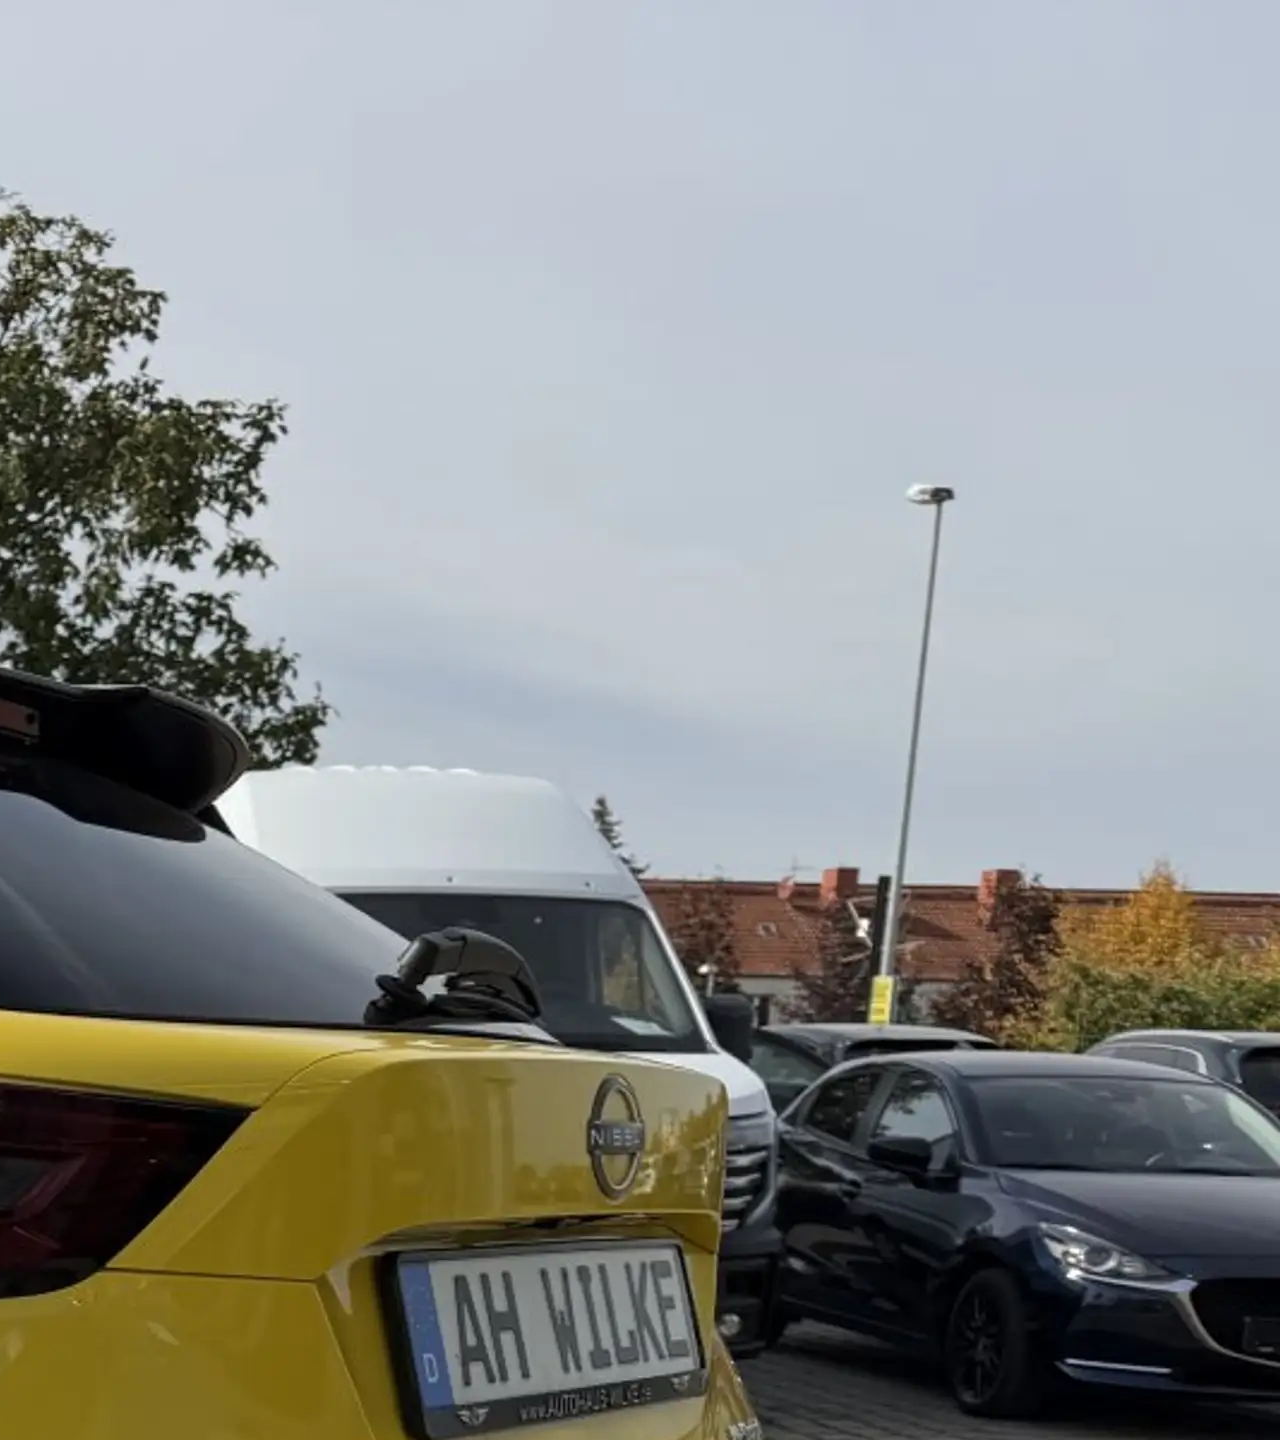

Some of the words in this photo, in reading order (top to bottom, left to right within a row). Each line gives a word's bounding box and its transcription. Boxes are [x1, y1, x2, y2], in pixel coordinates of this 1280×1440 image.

[591, 1126, 642, 1147] NISS
[454, 1270, 531, 1387] AH
[540, 1260, 689, 1373] WILKE
[424, 1353, 438, 1383] D
